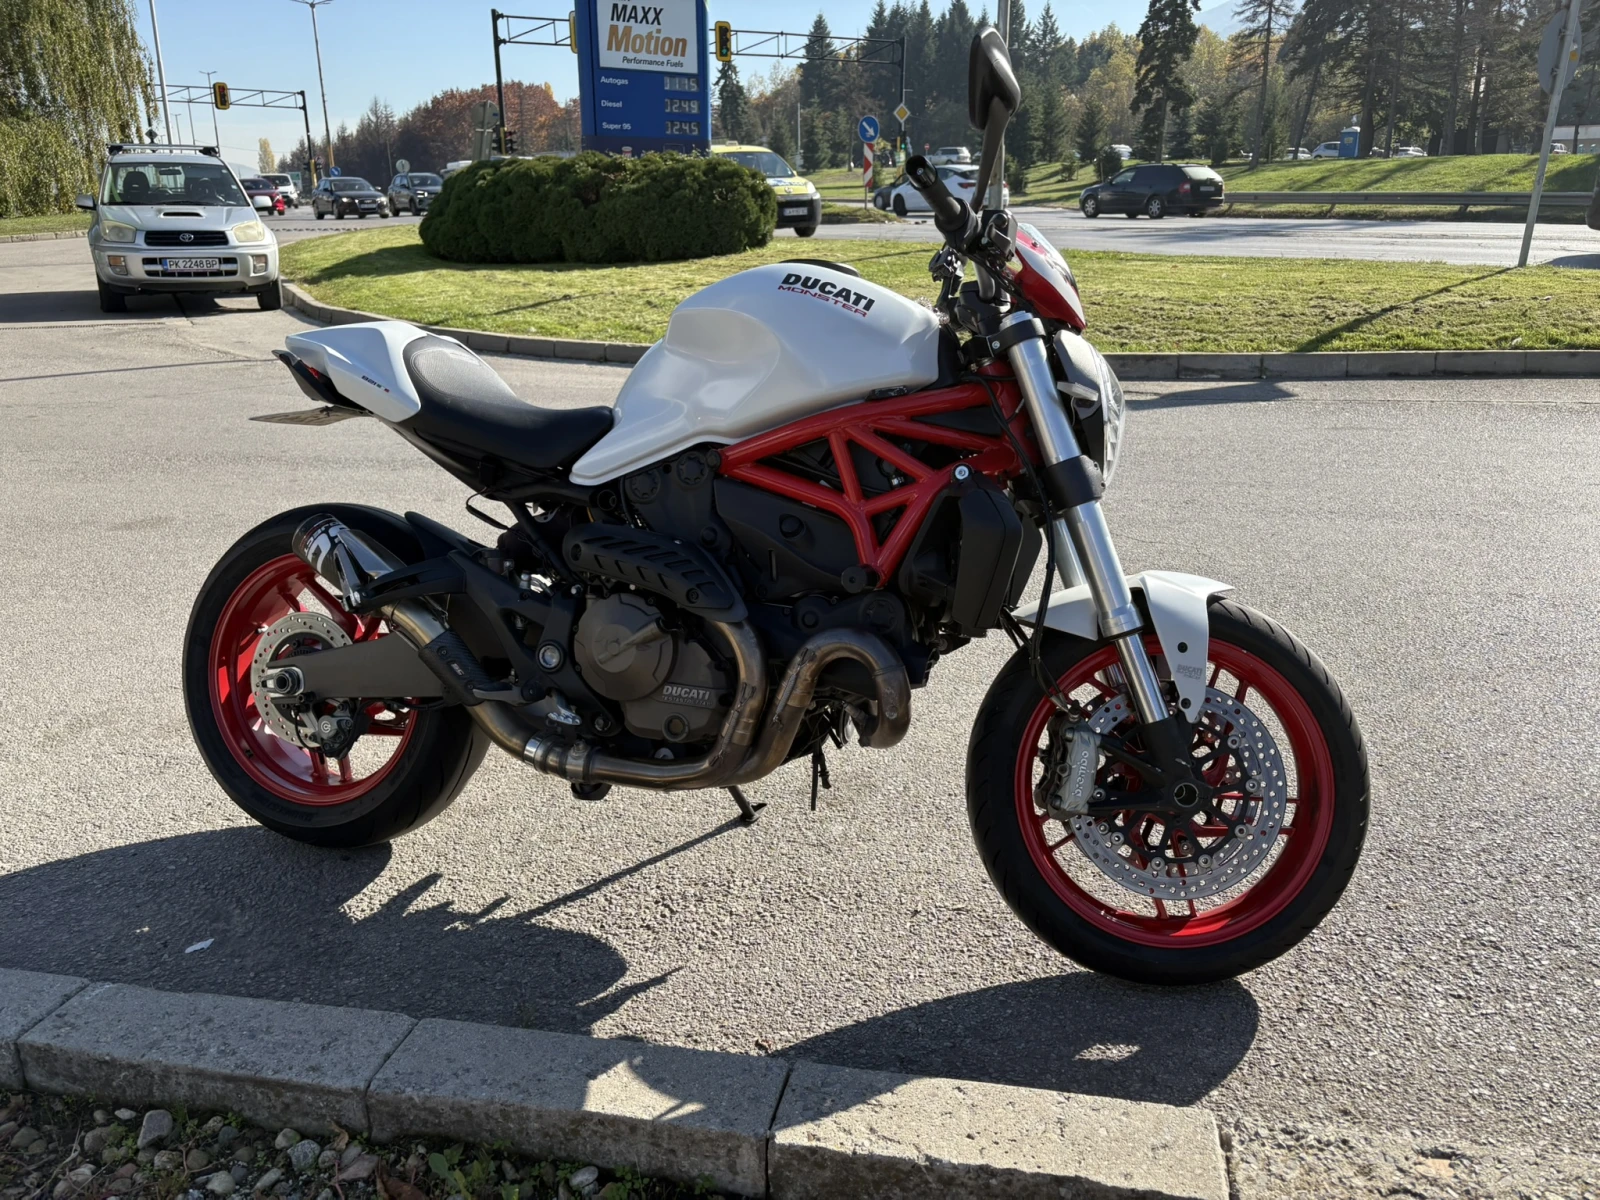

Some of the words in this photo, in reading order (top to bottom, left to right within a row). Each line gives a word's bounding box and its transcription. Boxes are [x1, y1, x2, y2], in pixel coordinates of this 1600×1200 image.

[610, 3, 664, 26] MAXX
[606, 24, 688, 57] Motion
[622, 56, 665, 67] Performance
[666, 59, 684, 68] Fuels
[600, 76, 629, 85] Autogas
[601, 99, 623, 108] Diesel
[602, 122, 621, 130] Super
[168, 259, 181, 269] PK
[182, 259, 205, 269] 2248
[206, 259, 218, 269] BP
[781, 273, 875, 312] DUCATI
[777, 285, 868, 318] MONSTER
[663, 685, 710, 700] DUCATI
[1071, 750, 1089, 797] brembo
